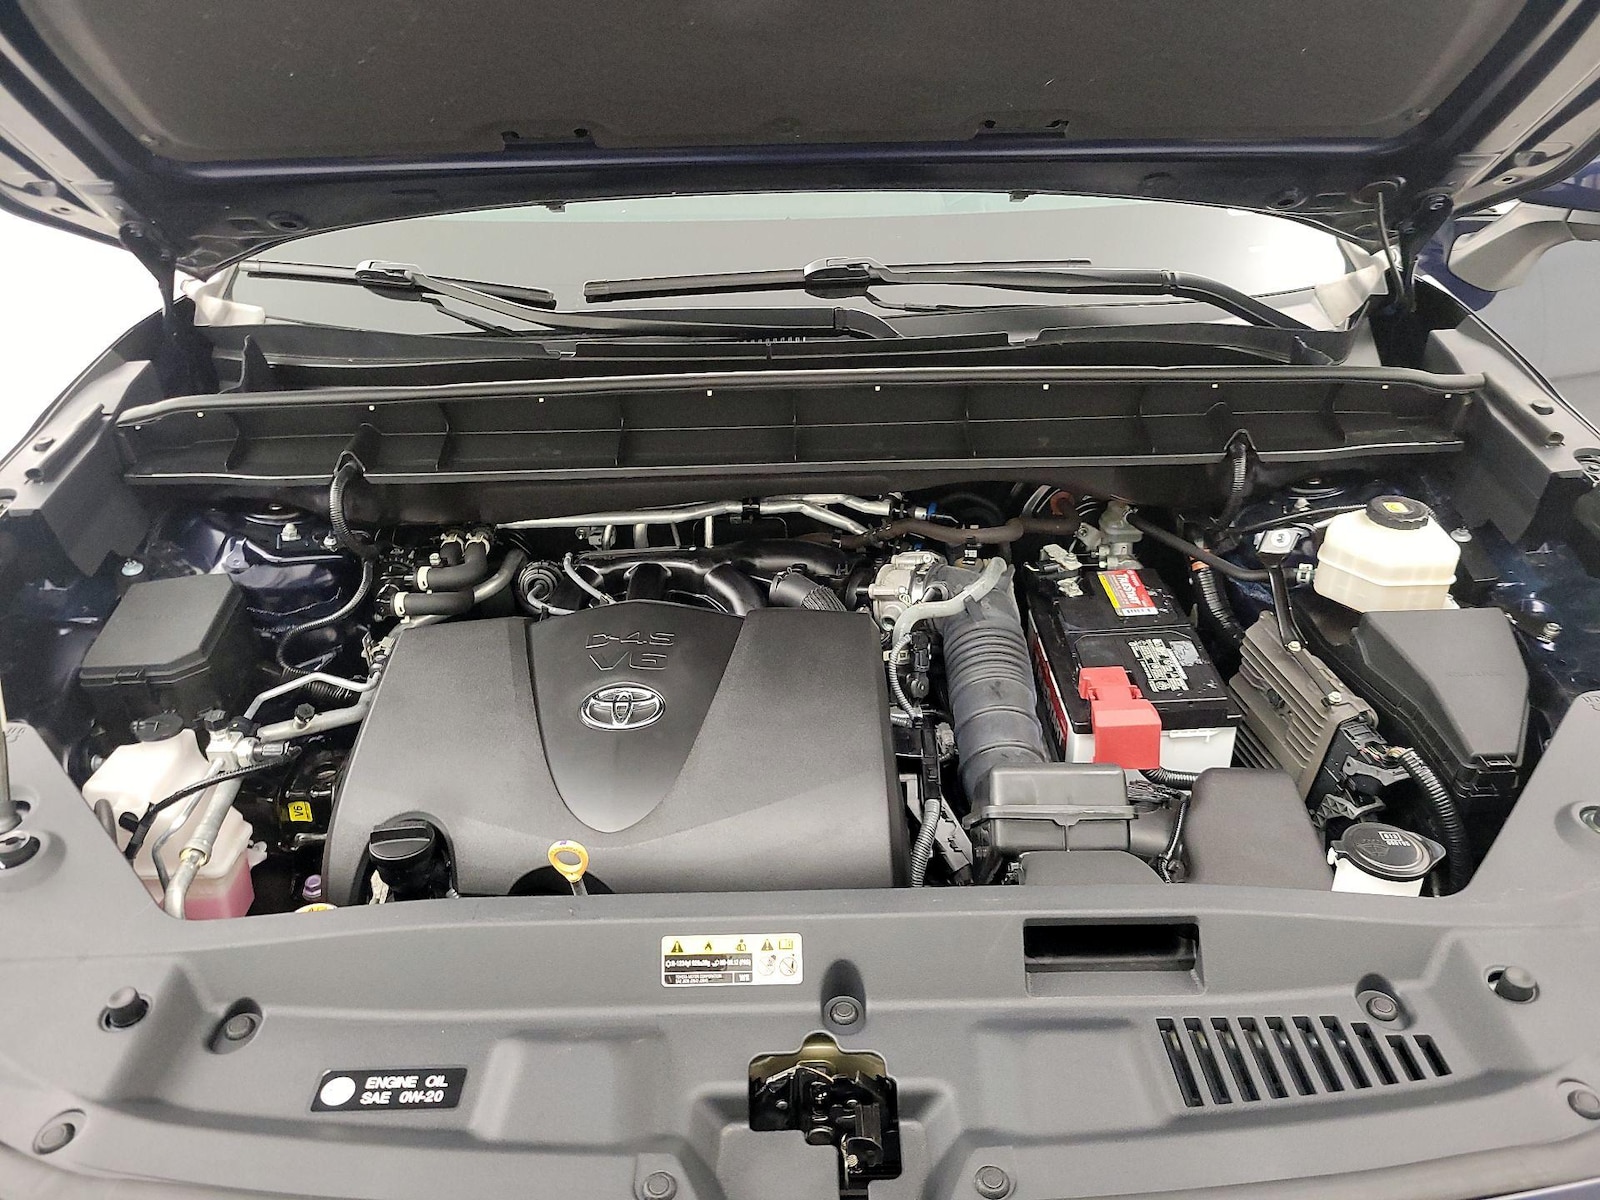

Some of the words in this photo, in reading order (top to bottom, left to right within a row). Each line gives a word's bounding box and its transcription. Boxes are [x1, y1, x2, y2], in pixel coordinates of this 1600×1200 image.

[585, 631, 675, 649] D-4S
[589, 650, 668, 671] V6
[293, 805, 304, 817] V6
[364, 1075, 419, 1089] ENGINE
[424, 1074, 449, 1088] OIL
[359, 1091, 393, 1105] SAE
[398, 1089, 444, 1104] 0W-20
